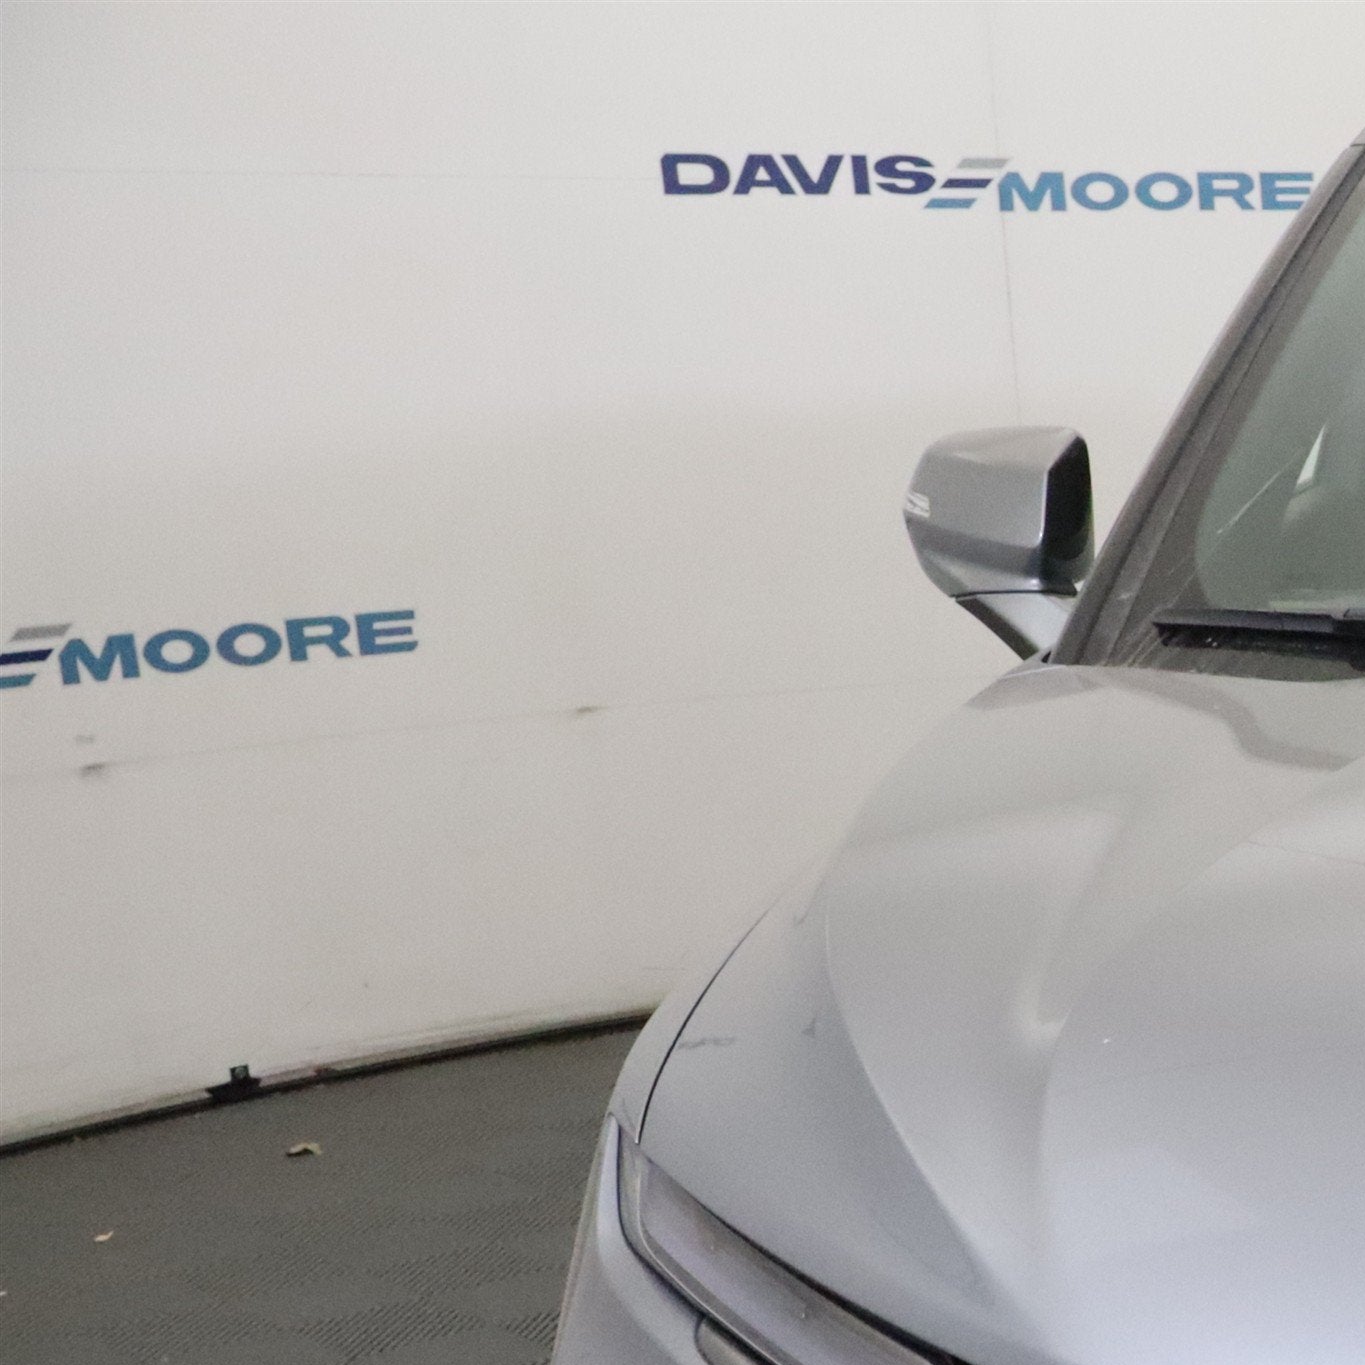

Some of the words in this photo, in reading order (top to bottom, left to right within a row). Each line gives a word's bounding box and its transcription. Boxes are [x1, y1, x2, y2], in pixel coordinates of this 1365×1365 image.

[659, 153, 936, 196] DAVIS
[997, 171, 1314, 212] MOORE
[58, 610, 418, 685] MOORE
